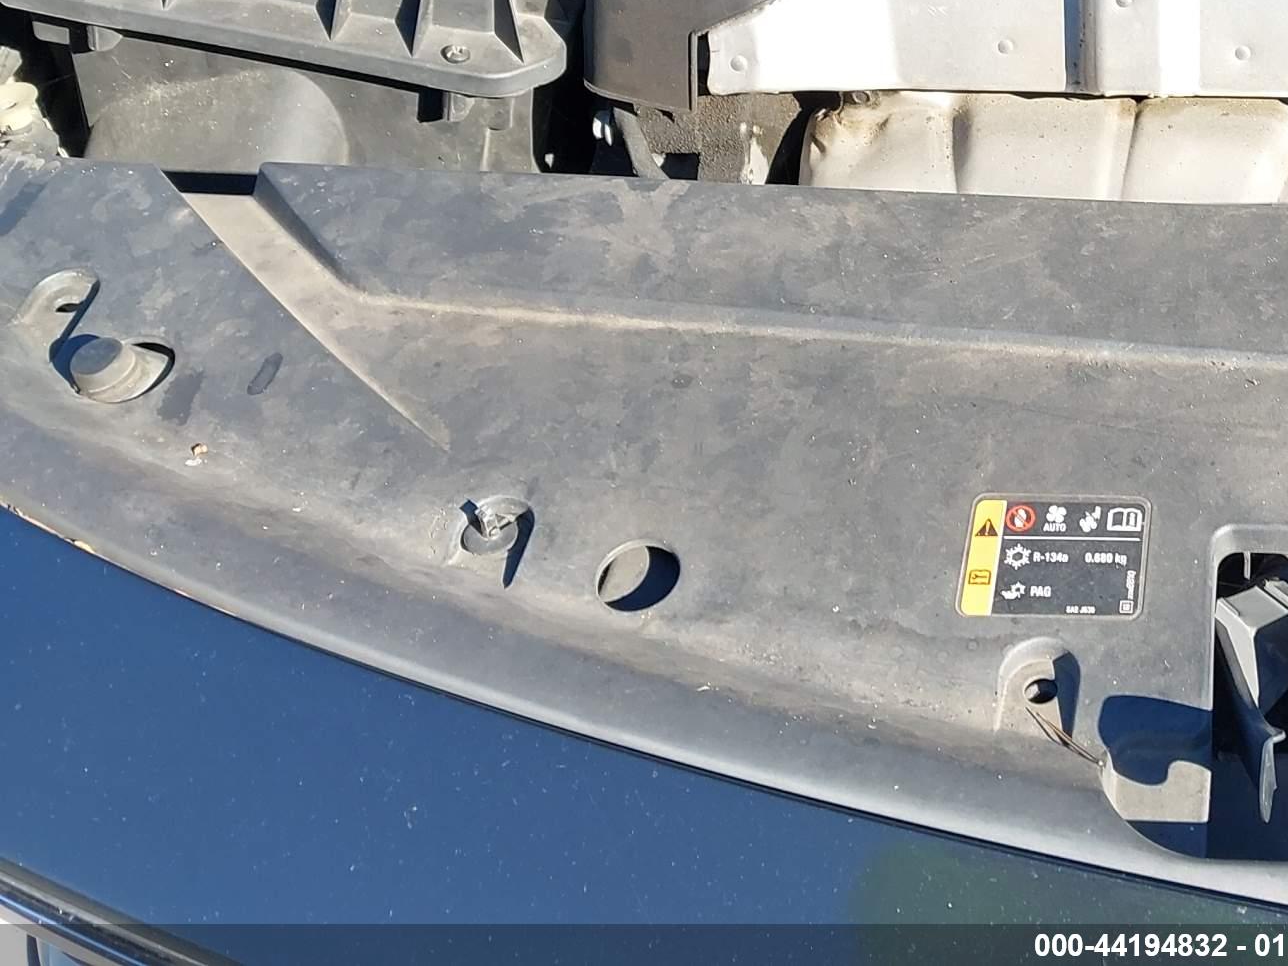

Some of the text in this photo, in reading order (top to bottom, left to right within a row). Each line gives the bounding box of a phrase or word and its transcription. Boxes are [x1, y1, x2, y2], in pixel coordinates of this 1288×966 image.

[1043, 522, 1067, 532] AUTO
[1033, 552, 1069, 563] R-134a
[1030, 586, 1052, 597] PAG
